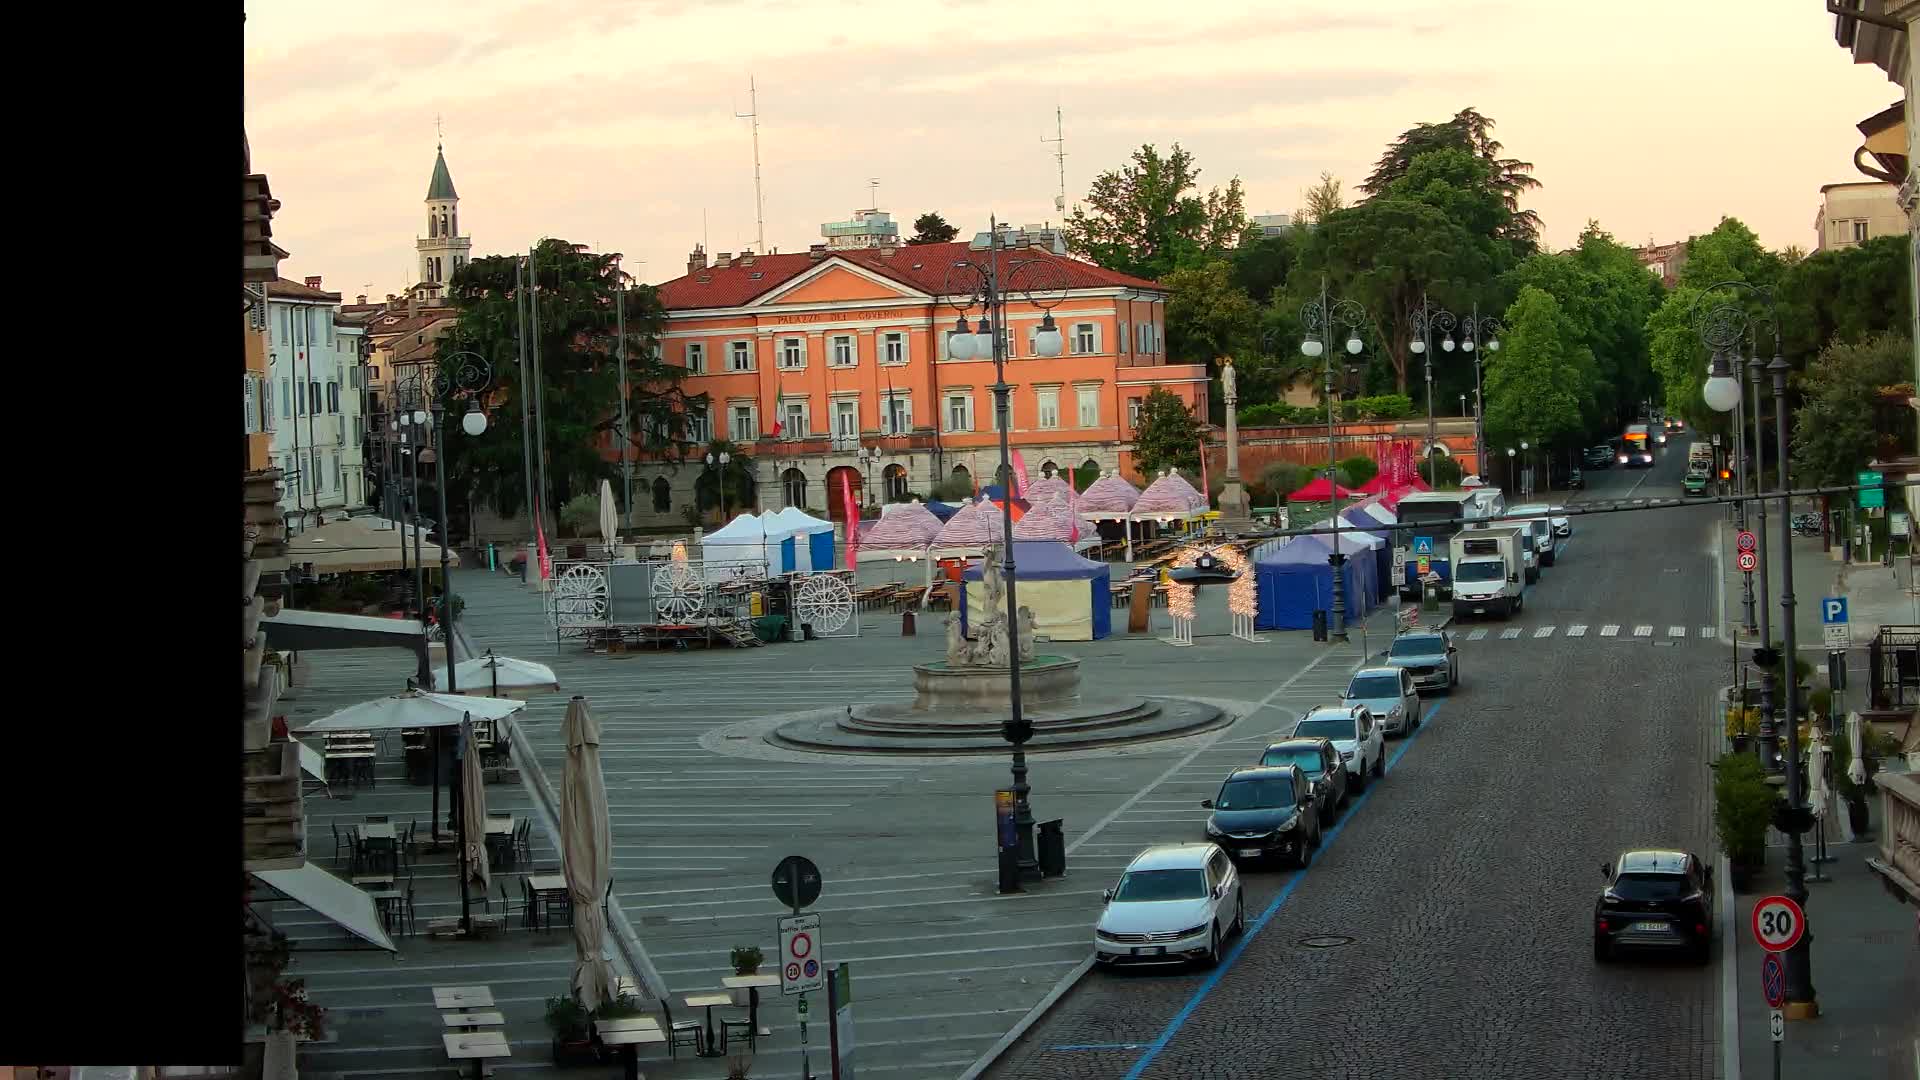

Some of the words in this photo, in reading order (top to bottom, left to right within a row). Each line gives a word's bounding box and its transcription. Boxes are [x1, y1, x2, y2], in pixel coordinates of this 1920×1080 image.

[777, 314, 820, 325] PALAZZO
[857, 310, 903, 321] GOVERNO
[1742, 557, 1752, 566] 20
[1827, 601, 1842, 621] P
[1762, 910, 1792, 936] 30
